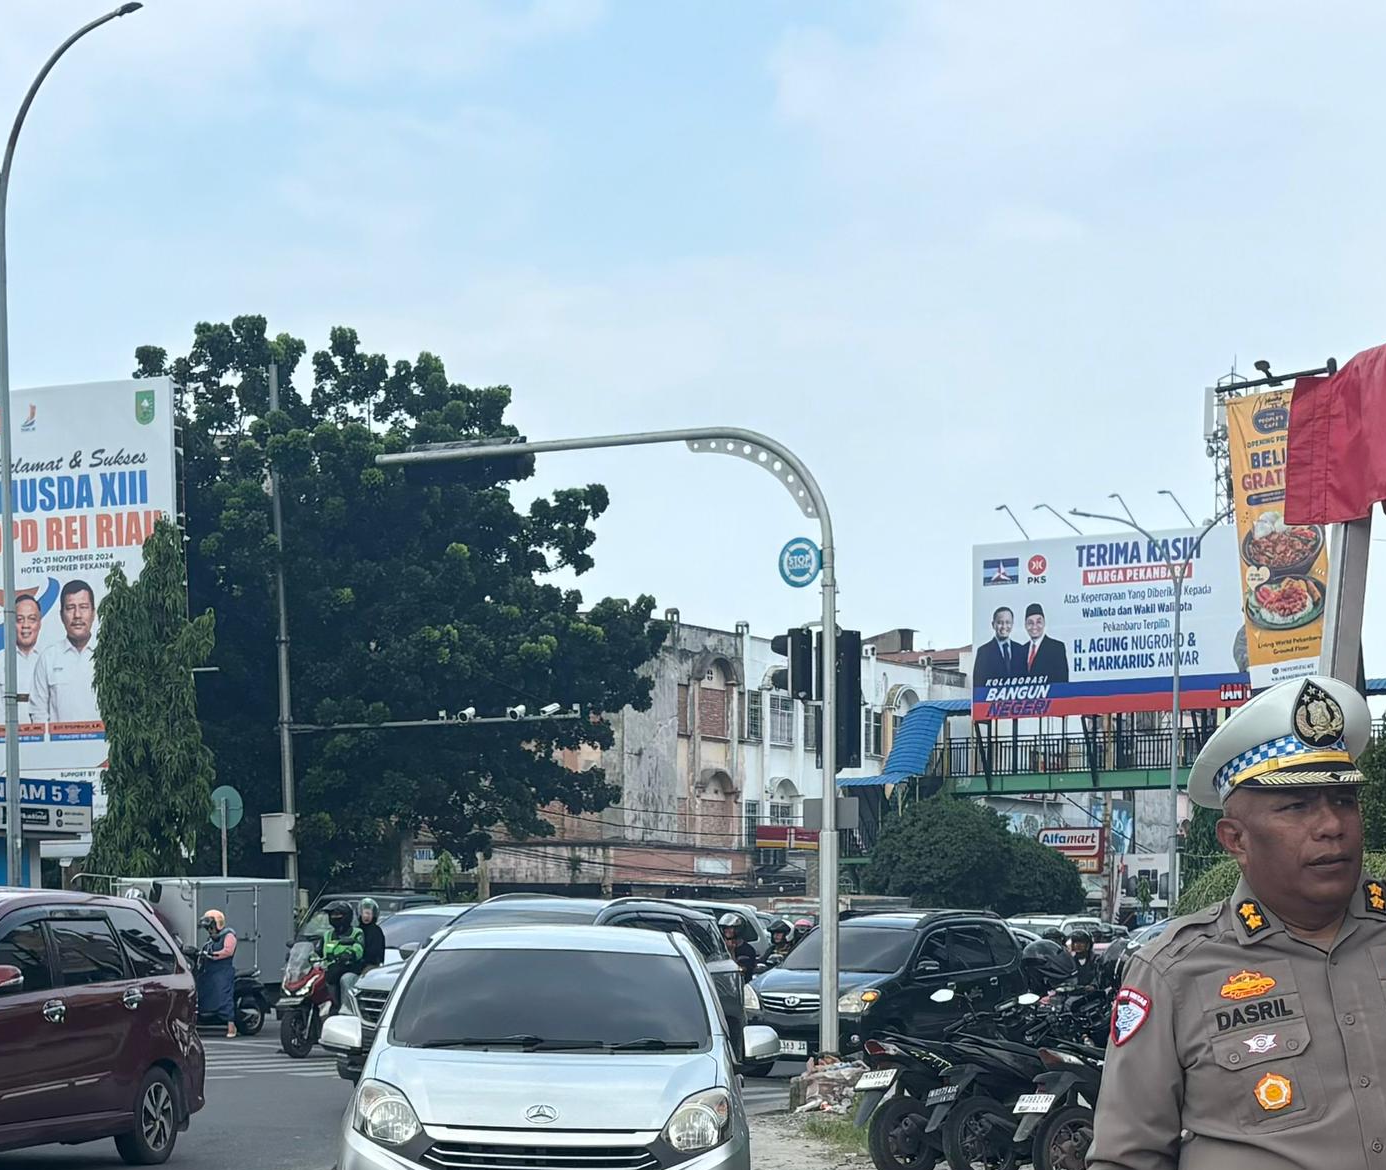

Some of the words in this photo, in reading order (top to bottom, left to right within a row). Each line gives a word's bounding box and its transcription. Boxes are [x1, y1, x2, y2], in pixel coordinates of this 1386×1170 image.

[69, 449, 83, 471] &
[89, 447, 149, 469] Sukses
[100, 469, 149, 508] XIII
[1241, 468, 1287, 492] GRAT
[46, 515, 89, 552] REI
[32, 556, 52, 566] 20-21
[53, 554, 94, 564] NOVEMBER
[96, 552, 115, 561] 2024
[1075, 541, 1142, 569] TERIMA
[1146, 536, 1202, 564] KASIH
[20, 565, 45, 574] HOTEL
[46, 564, 79, 573] PREMIER
[1087, 568, 1125, 585] WARGA
[1027, 575, 1047, 585] PKS
[1063, 593, 1080, 605] Atas
[1081, 591, 1127, 604] Kepercayaan
[1128, 588, 1146, 601] Yang
[1183, 584, 1212, 597] Kepada
[1082, 605, 1116, 620] Walikota
[1116, 604, 1132, 617] dan
[1133, 602, 1156, 615] Wakil
[1157, 601, 1193, 614] Waliota
[1103, 621, 1142, 633] Pekanbaru
[1143, 617, 1171, 631] Terpilih
[1073, 637, 1087, 654] H.
[1089, 634, 1129, 654] AGUNG
[1186, 631, 1197, 648] &
[1073, 656, 1087, 673] H.
[1088, 652, 1156, 672] MARKARIUS
[985, 676, 1048, 688] KOLABORASI
[986, 685, 1051, 702] BANGUN
[987, 699, 1052, 718] NEGERI
[51, 785, 63, 802] 5
[1042, 831, 1097, 845] Alfamart
[1215, 998, 1294, 1032] DASRIL
